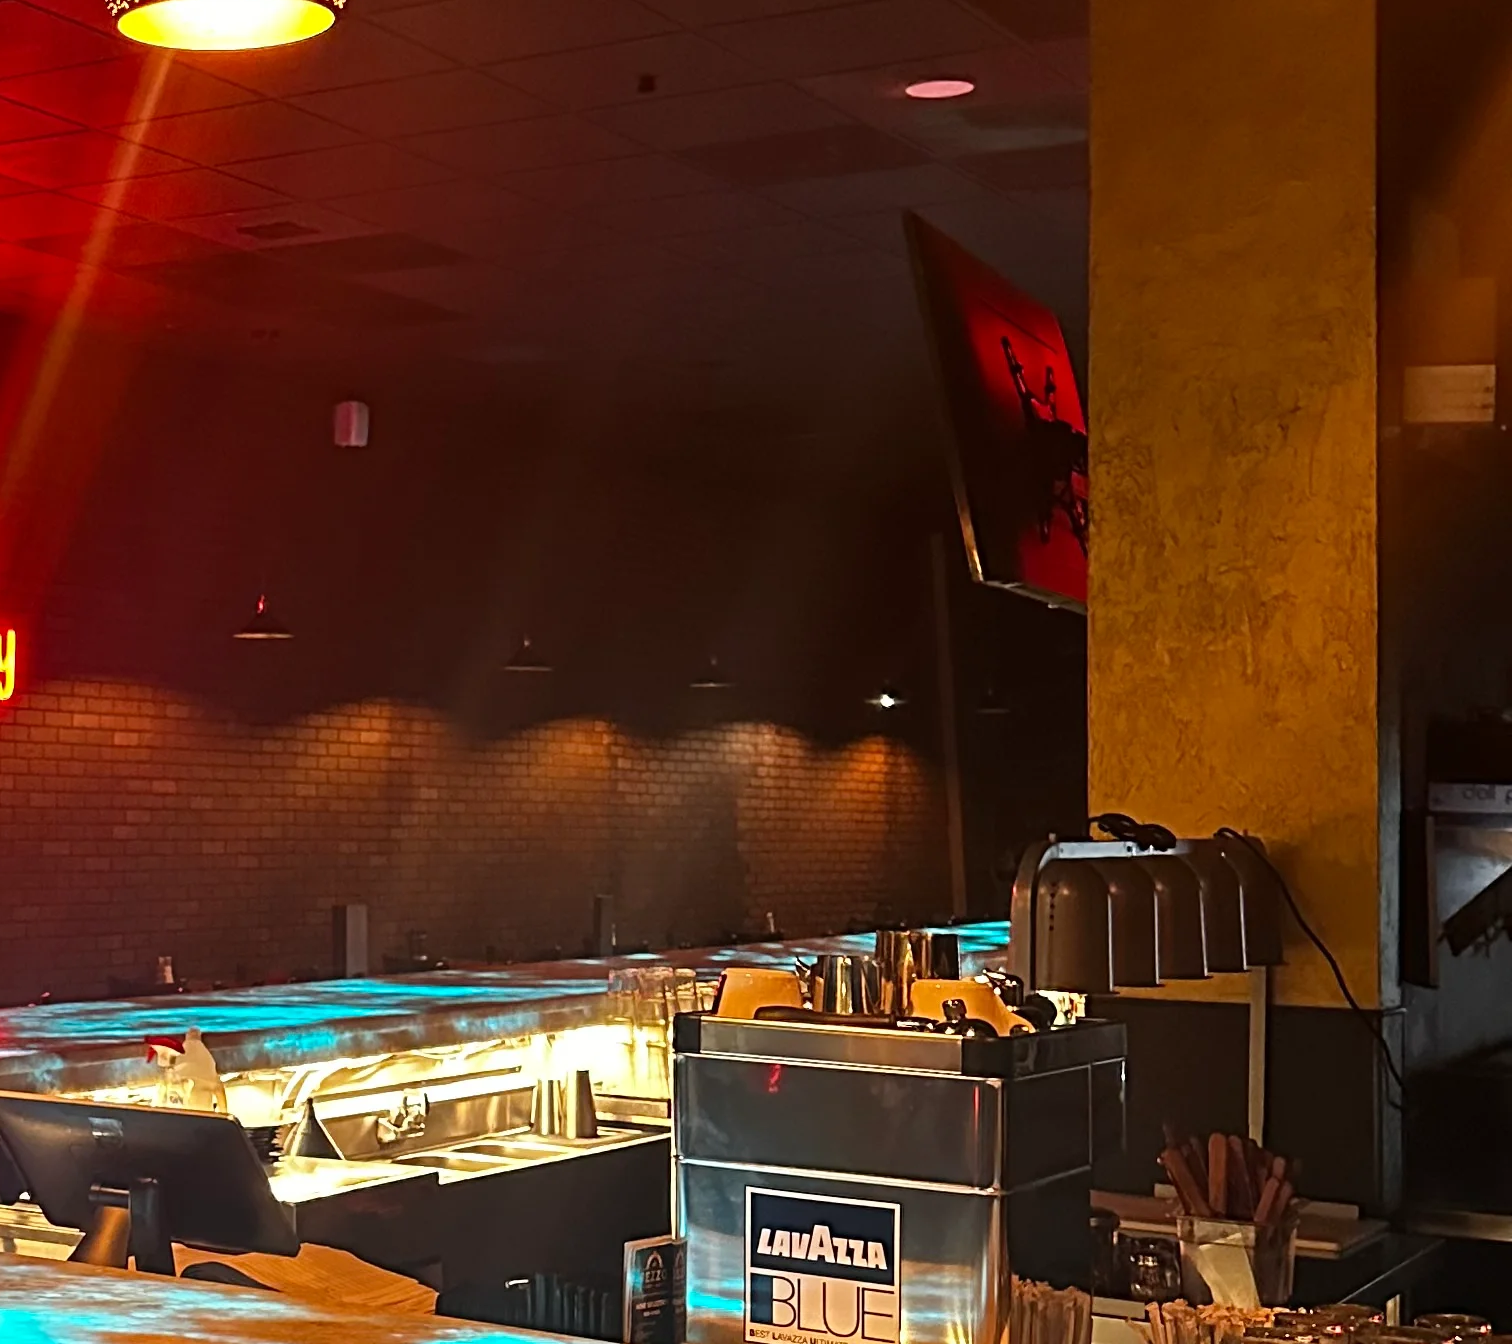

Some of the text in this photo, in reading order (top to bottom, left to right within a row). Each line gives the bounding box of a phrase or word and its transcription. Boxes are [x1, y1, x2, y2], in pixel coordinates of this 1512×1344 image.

[756, 1224, 888, 1271] LAVAZZA
[750, 1272, 895, 1344] BLUE
[749, 1328, 770, 1340] BEST
[772, 1332, 808, 1344] LAVAZZA
